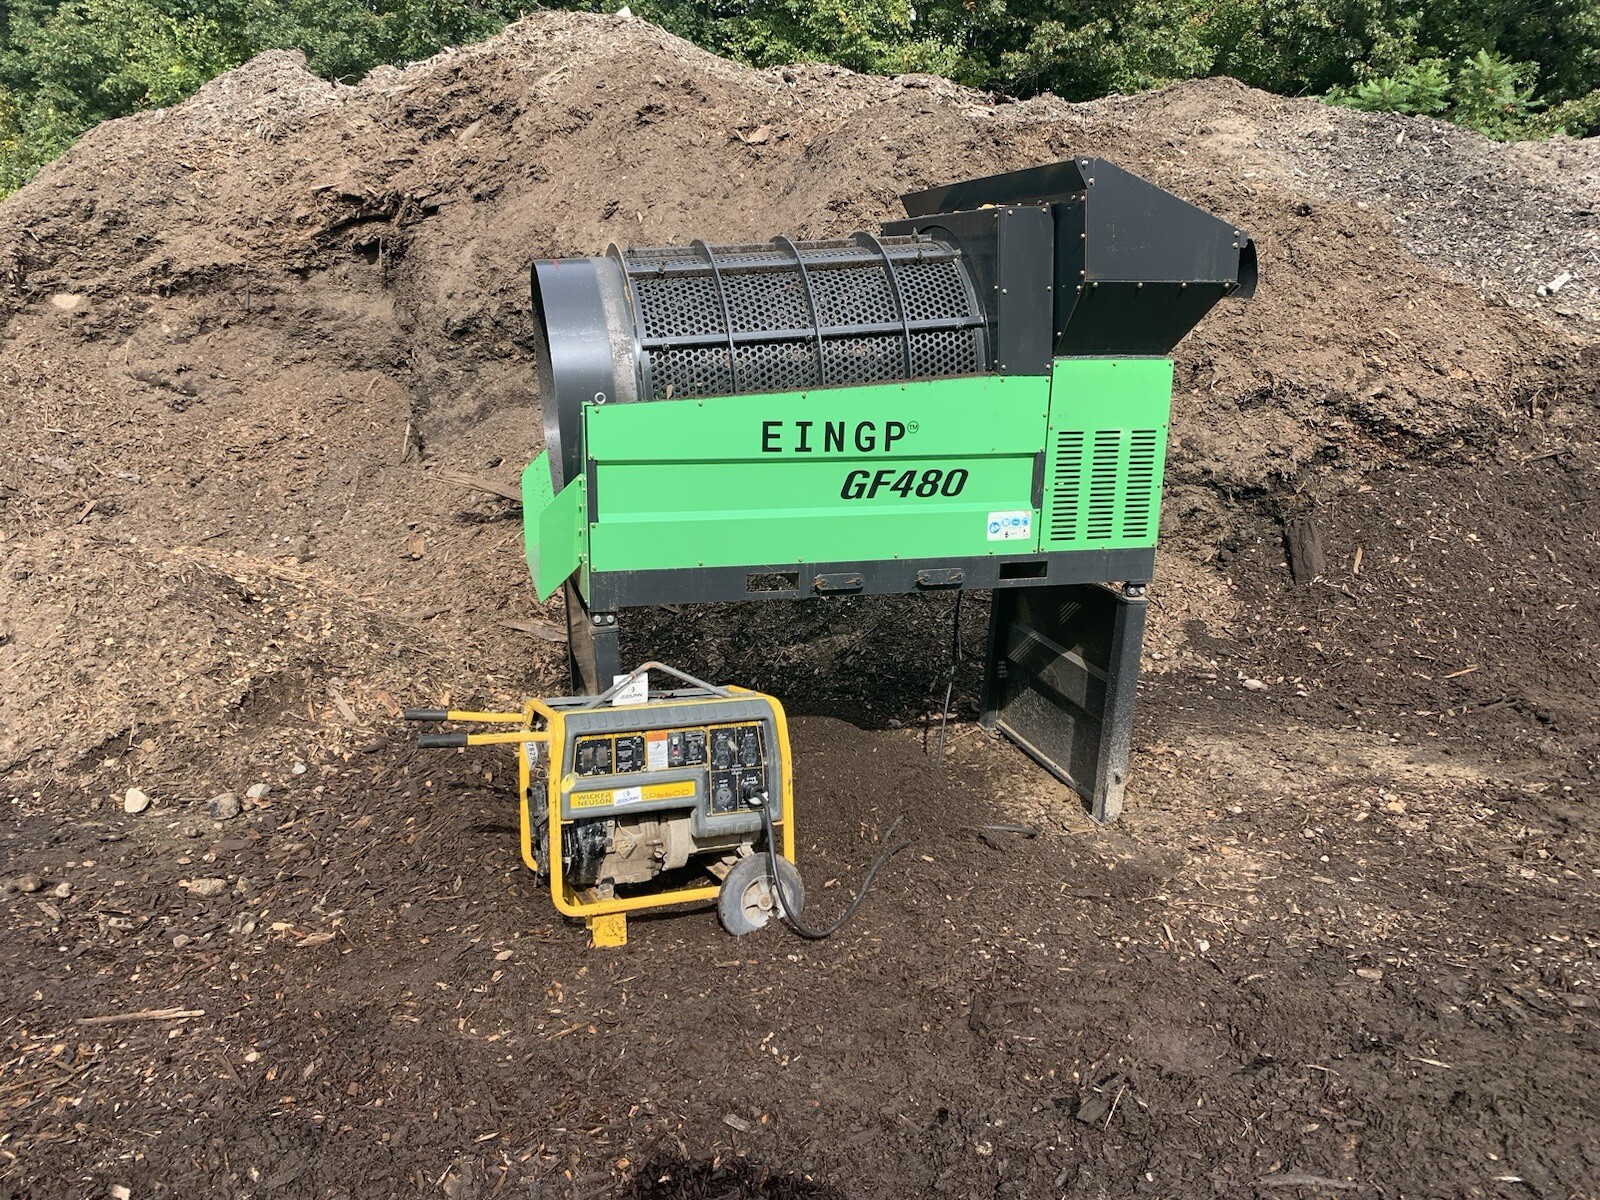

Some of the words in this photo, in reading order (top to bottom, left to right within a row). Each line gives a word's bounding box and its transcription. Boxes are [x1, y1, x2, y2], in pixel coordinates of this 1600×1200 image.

[761, 420, 906, 453] EINGP
[840, 468, 969, 500] GF480
[577, 791, 612, 800] WACKER
[641, 788, 690, 800] GP6600
[577, 798, 612, 807] NEUSON
